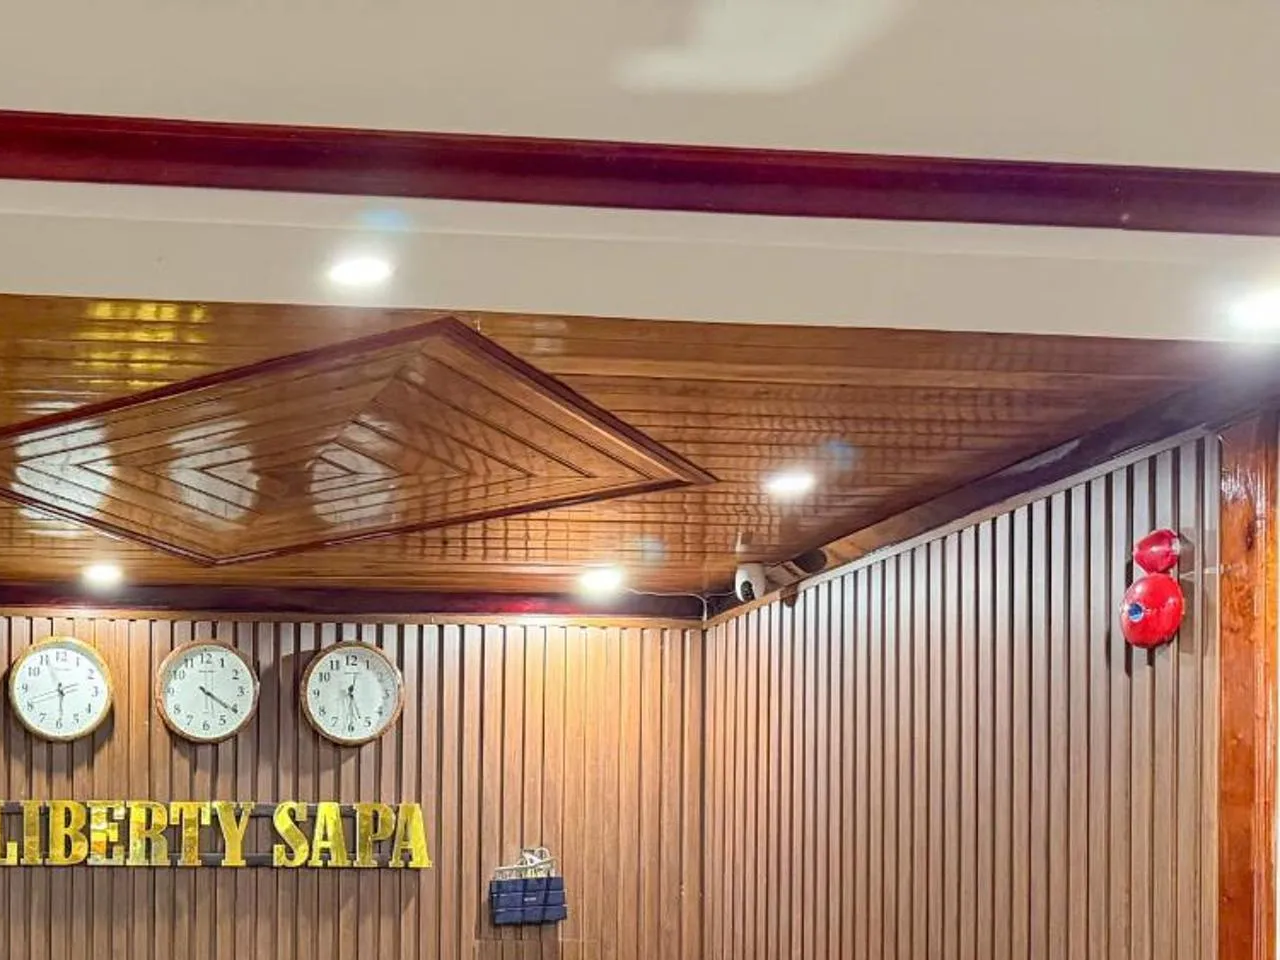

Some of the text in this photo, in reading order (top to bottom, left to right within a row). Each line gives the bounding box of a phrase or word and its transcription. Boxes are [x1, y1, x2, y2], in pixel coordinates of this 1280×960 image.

[55, 651, 67, 662] 12
[200, 653, 213, 664] 12
[345, 655, 358, 666] 12
[184, 658, 194, 668] 11
[330, 660, 340, 670] 11
[28, 667, 40, 677] 10
[88, 668, 95, 680] 2
[172, 669, 186, 680] 10
[232, 668, 239, 680] 2
[319, 672, 330, 682] 10
[22, 683, 28, 693] 9
[91, 686, 99, 697] 3
[167, 686, 175, 696] 9
[236, 686, 245, 697] 3
[313, 688, 320, 698] 9
[173, 704, 181, 714] 8
[318, 706, 326, 716] 8
[39, 712, 47, 723] 7
[73, 712, 79, 724] 5
[186, 714, 194, 726] 7
[219, 714, 226, 726] 5
[331, 717, 338, 727] 7
[364, 716, 371, 728] 5
[202, 720, 210, 731] 6
[347, 721, 355, 732] 6
[272, 801, 433, 868] SAPA
